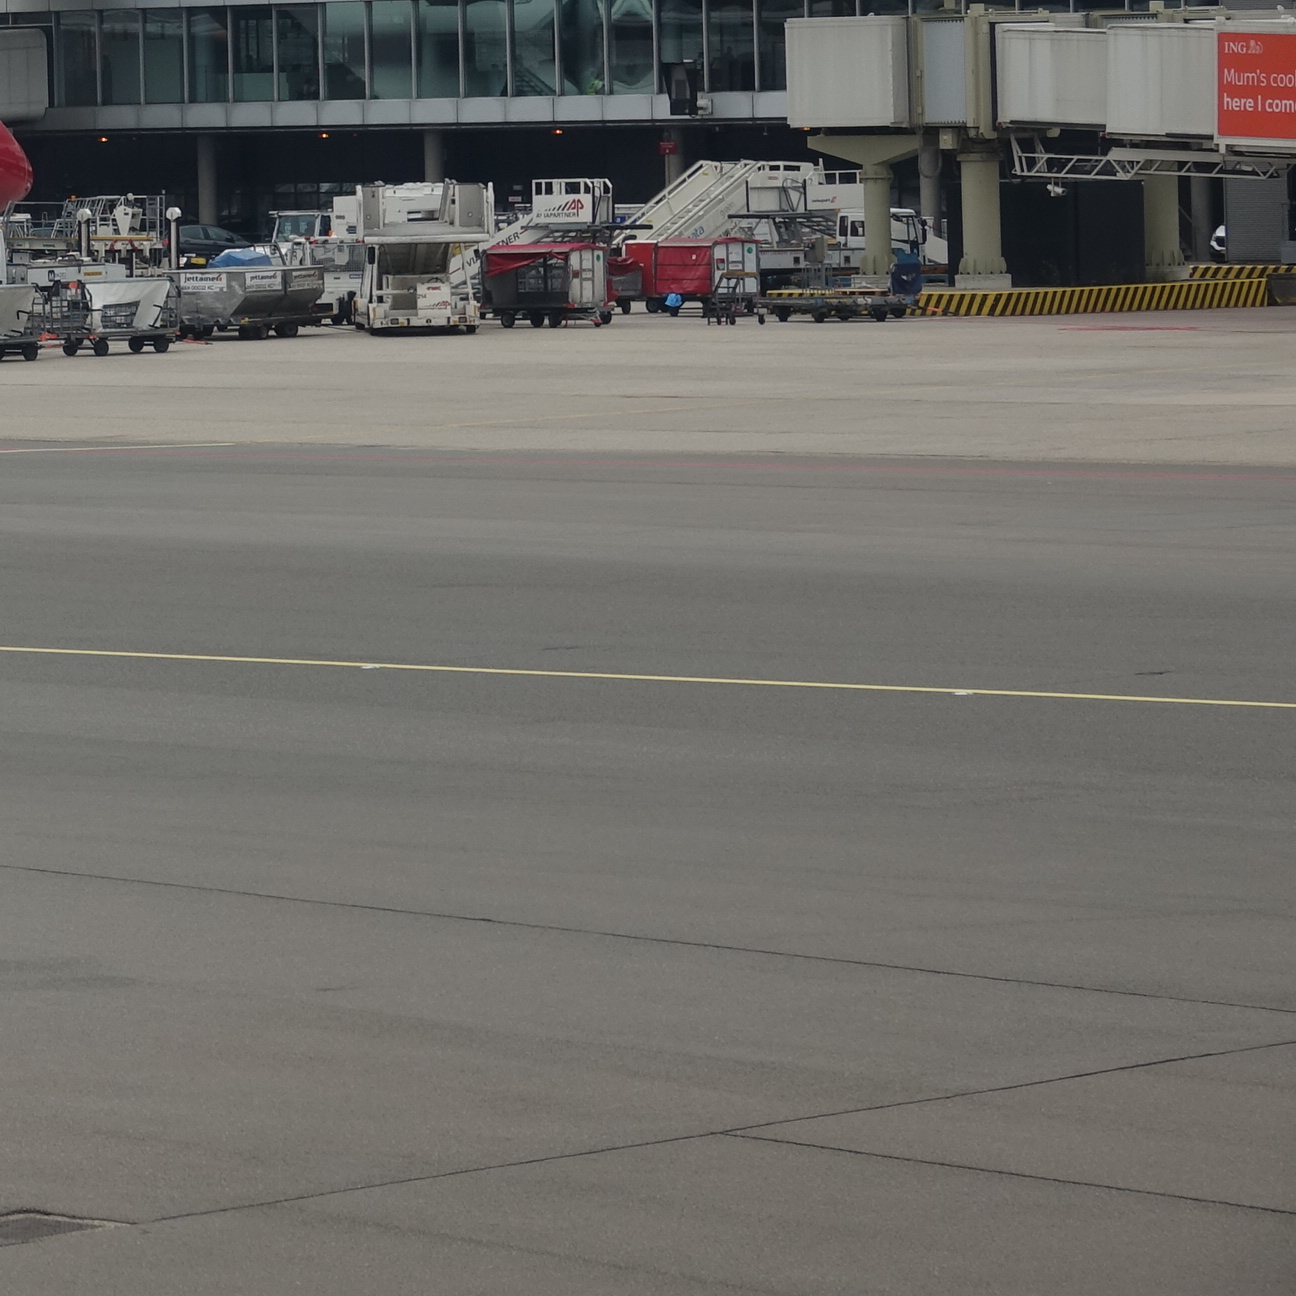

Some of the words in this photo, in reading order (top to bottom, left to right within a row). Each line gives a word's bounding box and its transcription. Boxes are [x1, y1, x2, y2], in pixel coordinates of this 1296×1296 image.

[1224, 41, 1247, 54] ING
[1224, 68, 1267, 86] Mum's
[1270, 70, 1296, 87] coo
[1224, 93, 1254, 111] here
